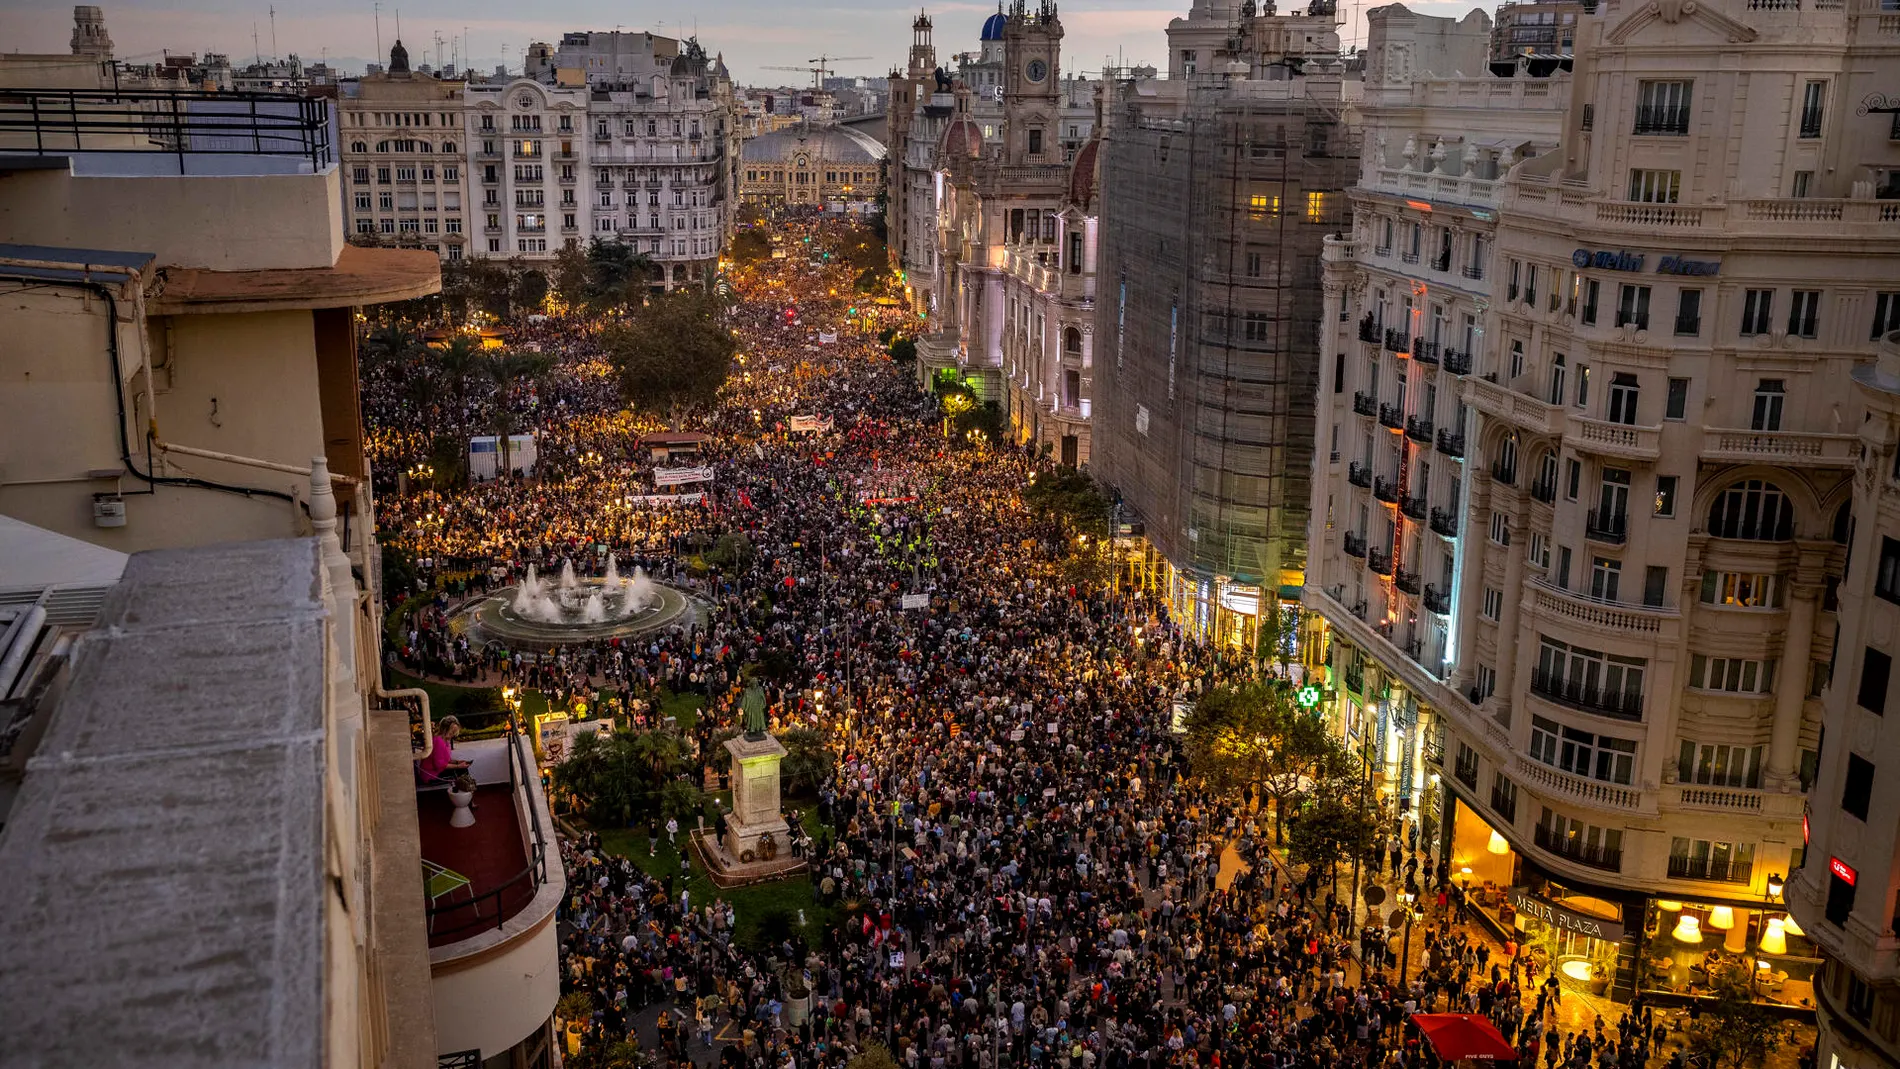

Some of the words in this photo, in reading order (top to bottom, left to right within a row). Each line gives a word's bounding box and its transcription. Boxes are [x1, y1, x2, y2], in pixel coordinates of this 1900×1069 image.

[1656, 254, 1721, 275] Plaza
[1517, 895, 1553, 923] MELIÁ
[1559, 914, 1602, 937] PLAZA
